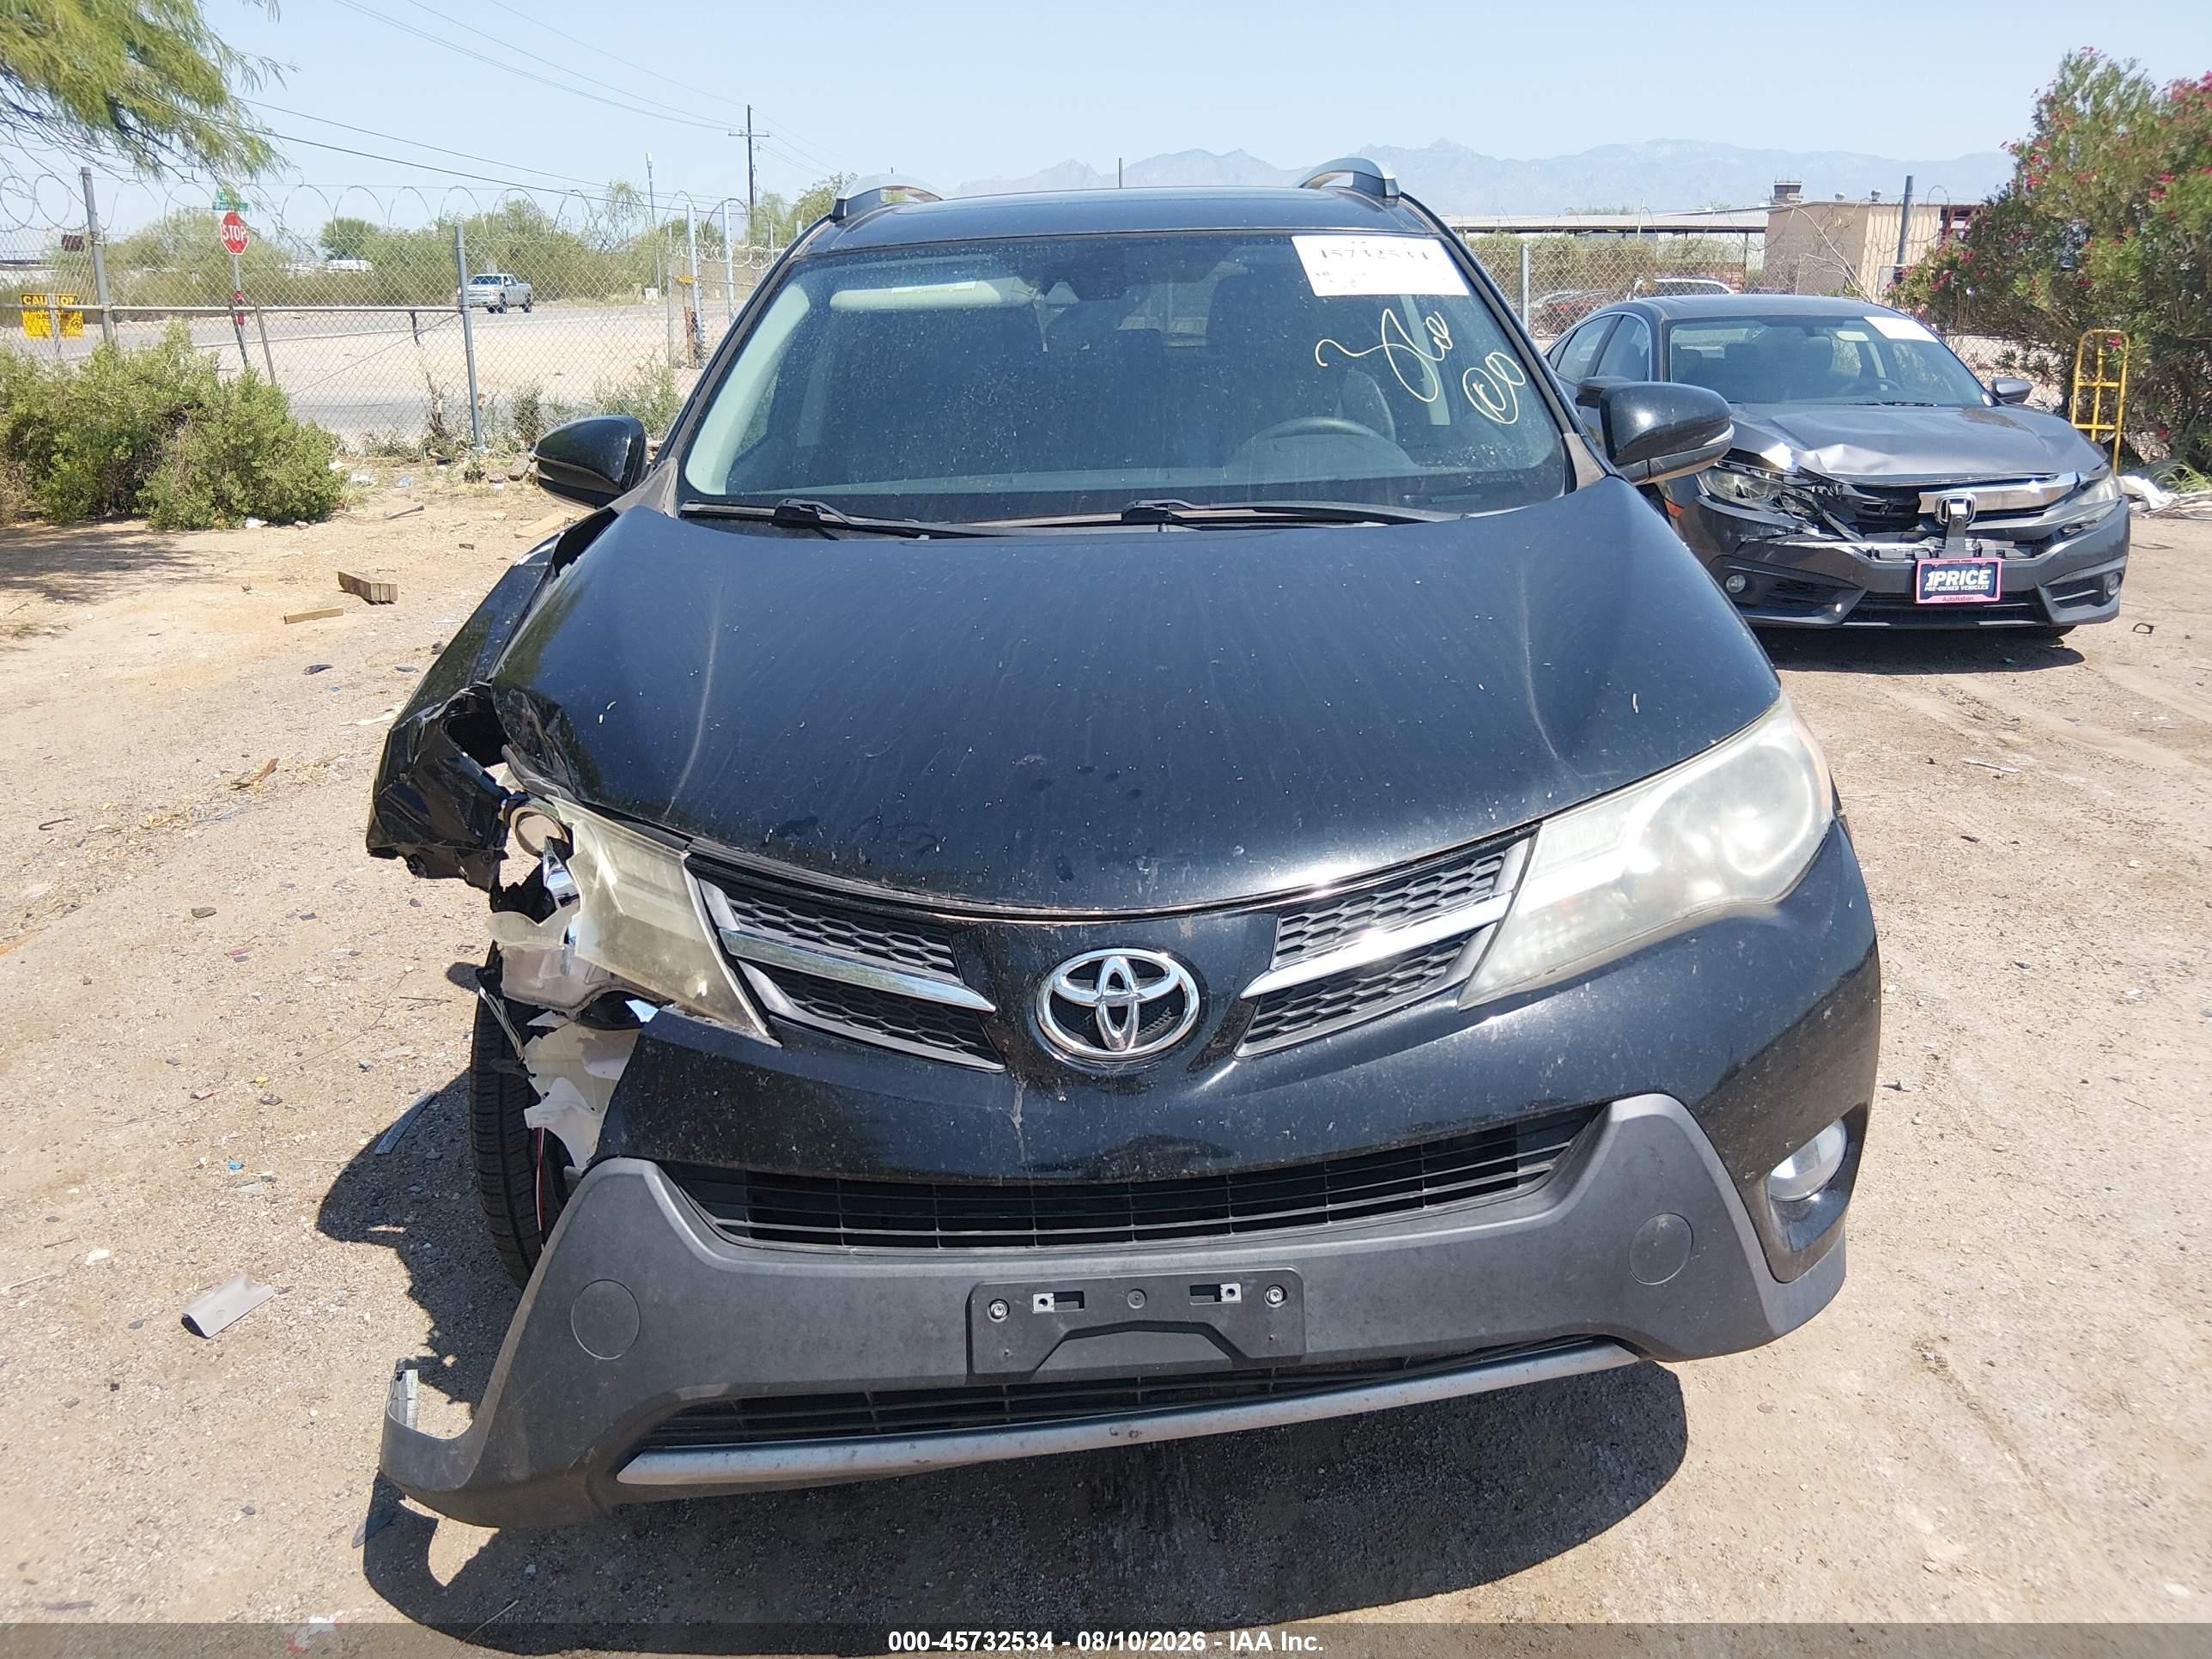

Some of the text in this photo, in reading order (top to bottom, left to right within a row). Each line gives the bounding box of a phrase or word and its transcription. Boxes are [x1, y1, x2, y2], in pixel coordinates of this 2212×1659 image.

[222, 224, 247, 241] STOP
[22, 295, 76, 306] CAUIO
[1925, 569, 1992, 586] 1PRICE
